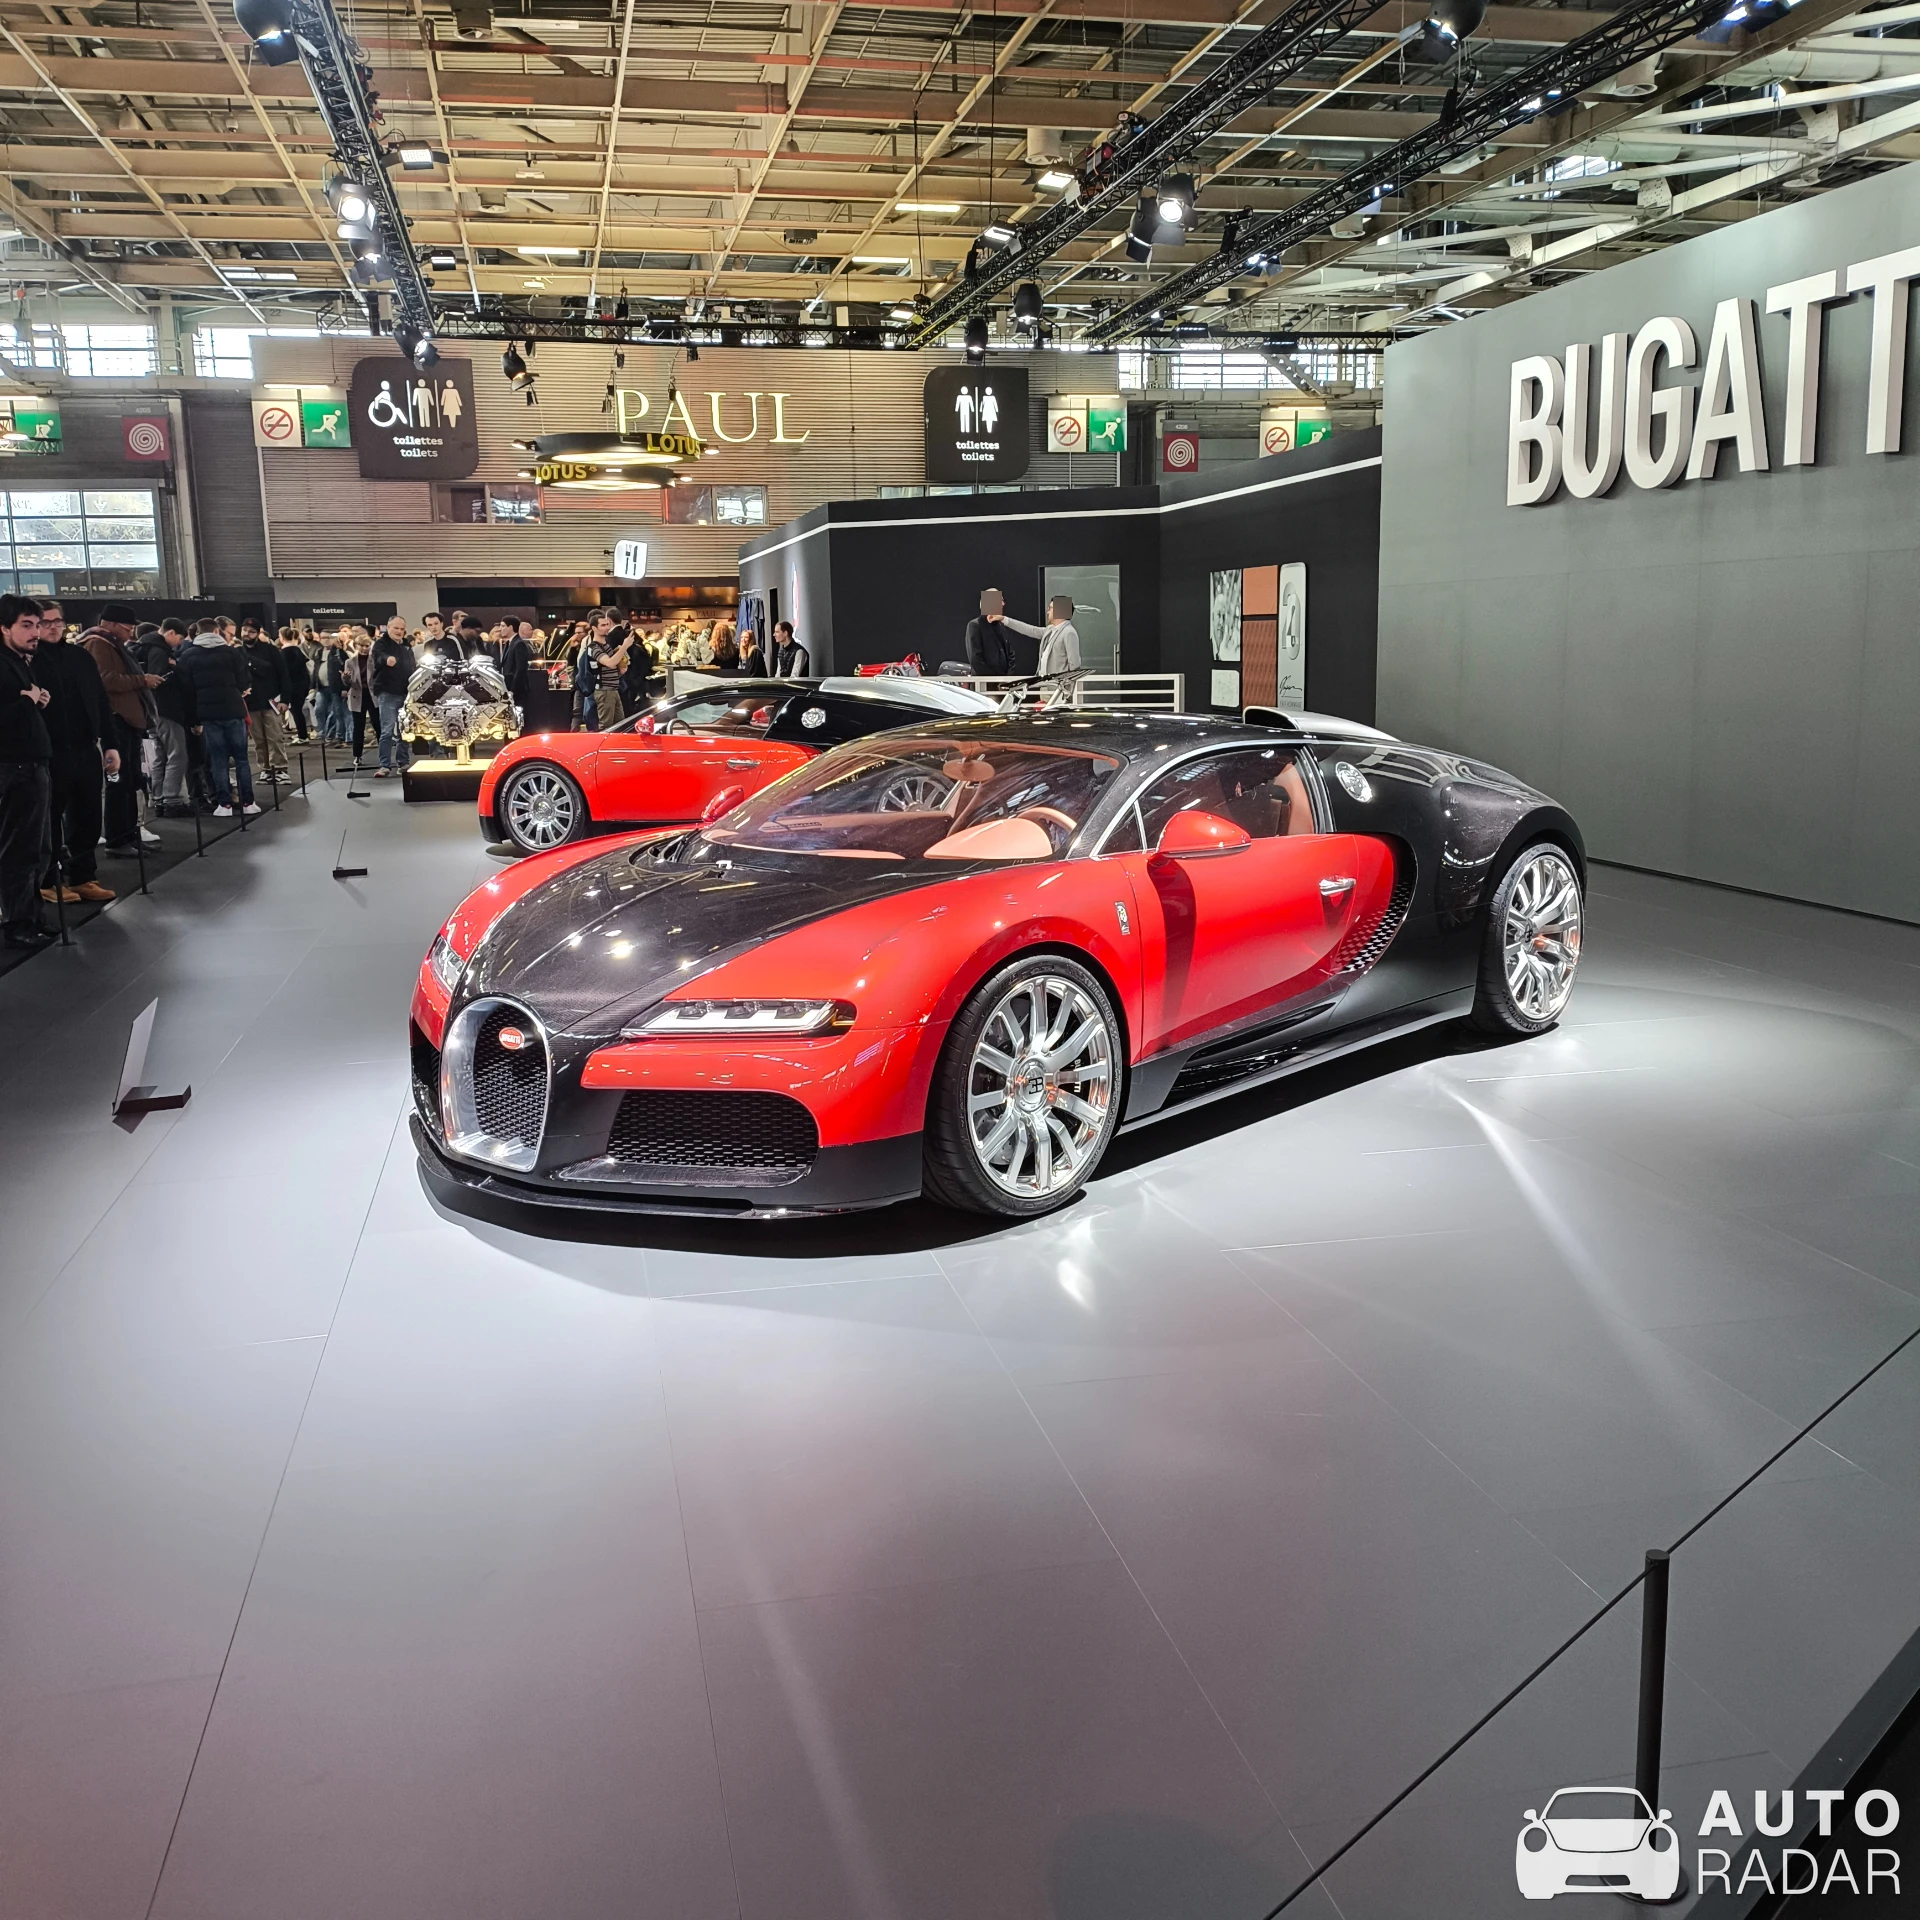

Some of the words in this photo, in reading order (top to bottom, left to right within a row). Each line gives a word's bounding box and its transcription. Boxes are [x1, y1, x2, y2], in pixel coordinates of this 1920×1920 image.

[616, 389, 810, 443] PAUL
[393, 436, 443, 445] toilettes
[646, 433, 701, 455] LOTUS
[956, 440, 1000, 449] toilettes
[400, 448, 438, 457] toilets
[962, 452, 995, 461] toilets
[535, 464, 587, 481] LOTUS
